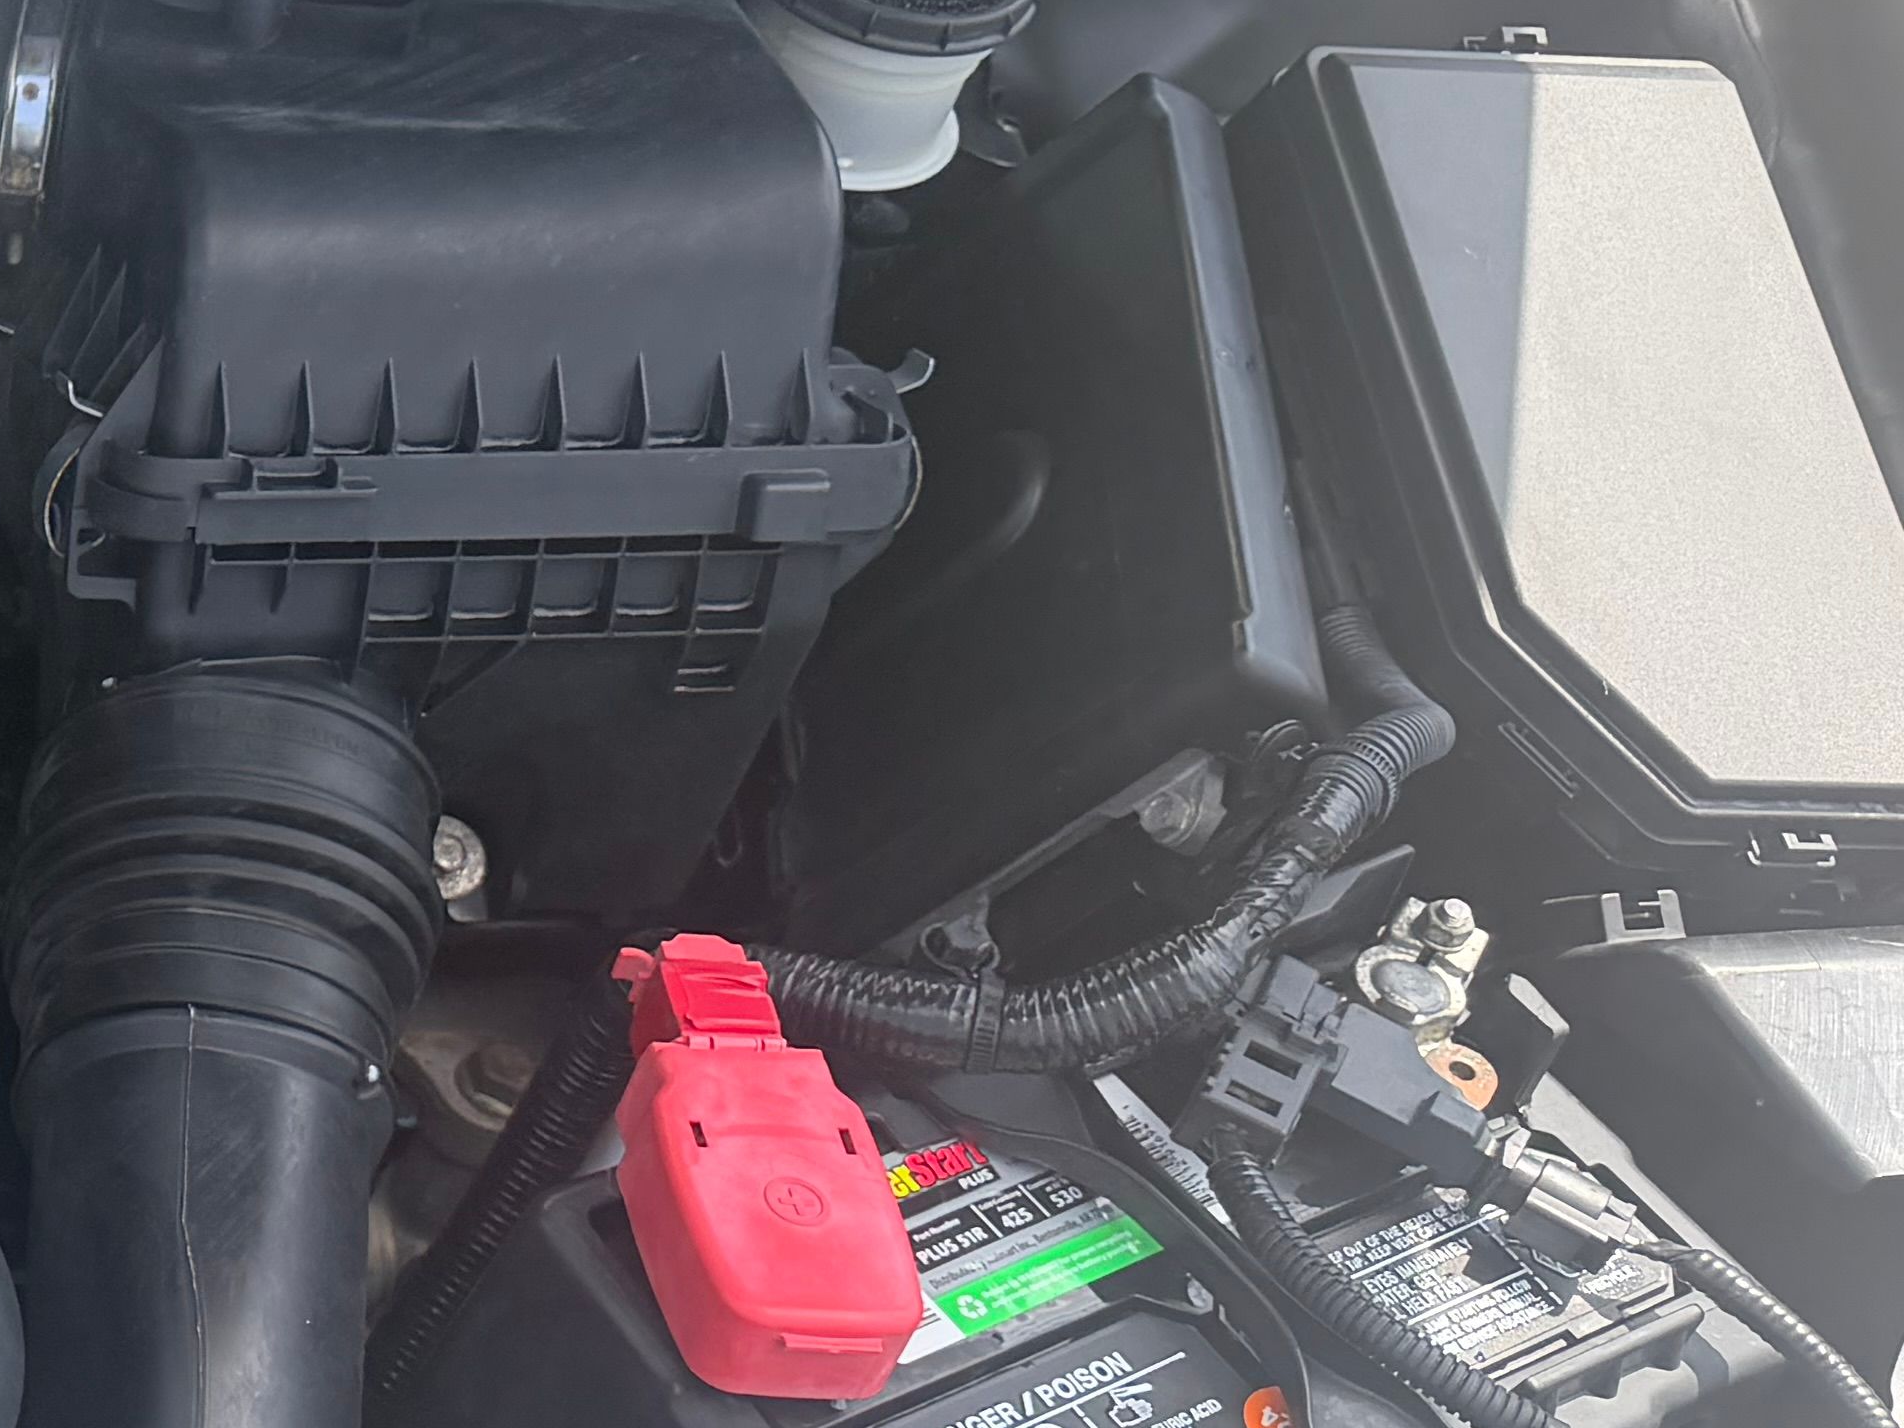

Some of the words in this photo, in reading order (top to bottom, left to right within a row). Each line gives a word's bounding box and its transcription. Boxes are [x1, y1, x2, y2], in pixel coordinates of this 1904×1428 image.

[958, 1165, 995, 1191] PLUS
[1049, 1184, 1084, 1209] 530
[1001, 1206, 1034, 1230] 425
[1379, 1225, 1404, 1242] THE
[1399, 1211, 1434, 1233] REACH
[915, 1240, 959, 1266] PLUS
[957, 1226, 989, 1250] 51R
[1365, 1243, 1392, 1262] KEEP
[1362, 1271, 1400, 1294] EYES
[1394, 1238, 1473, 1280] IMMEDIATELY
[1413, 1270, 1444, 1291] GET
[1035, 1351, 1134, 1407] POISON
[1190, 1398, 1223, 1422] ACID
